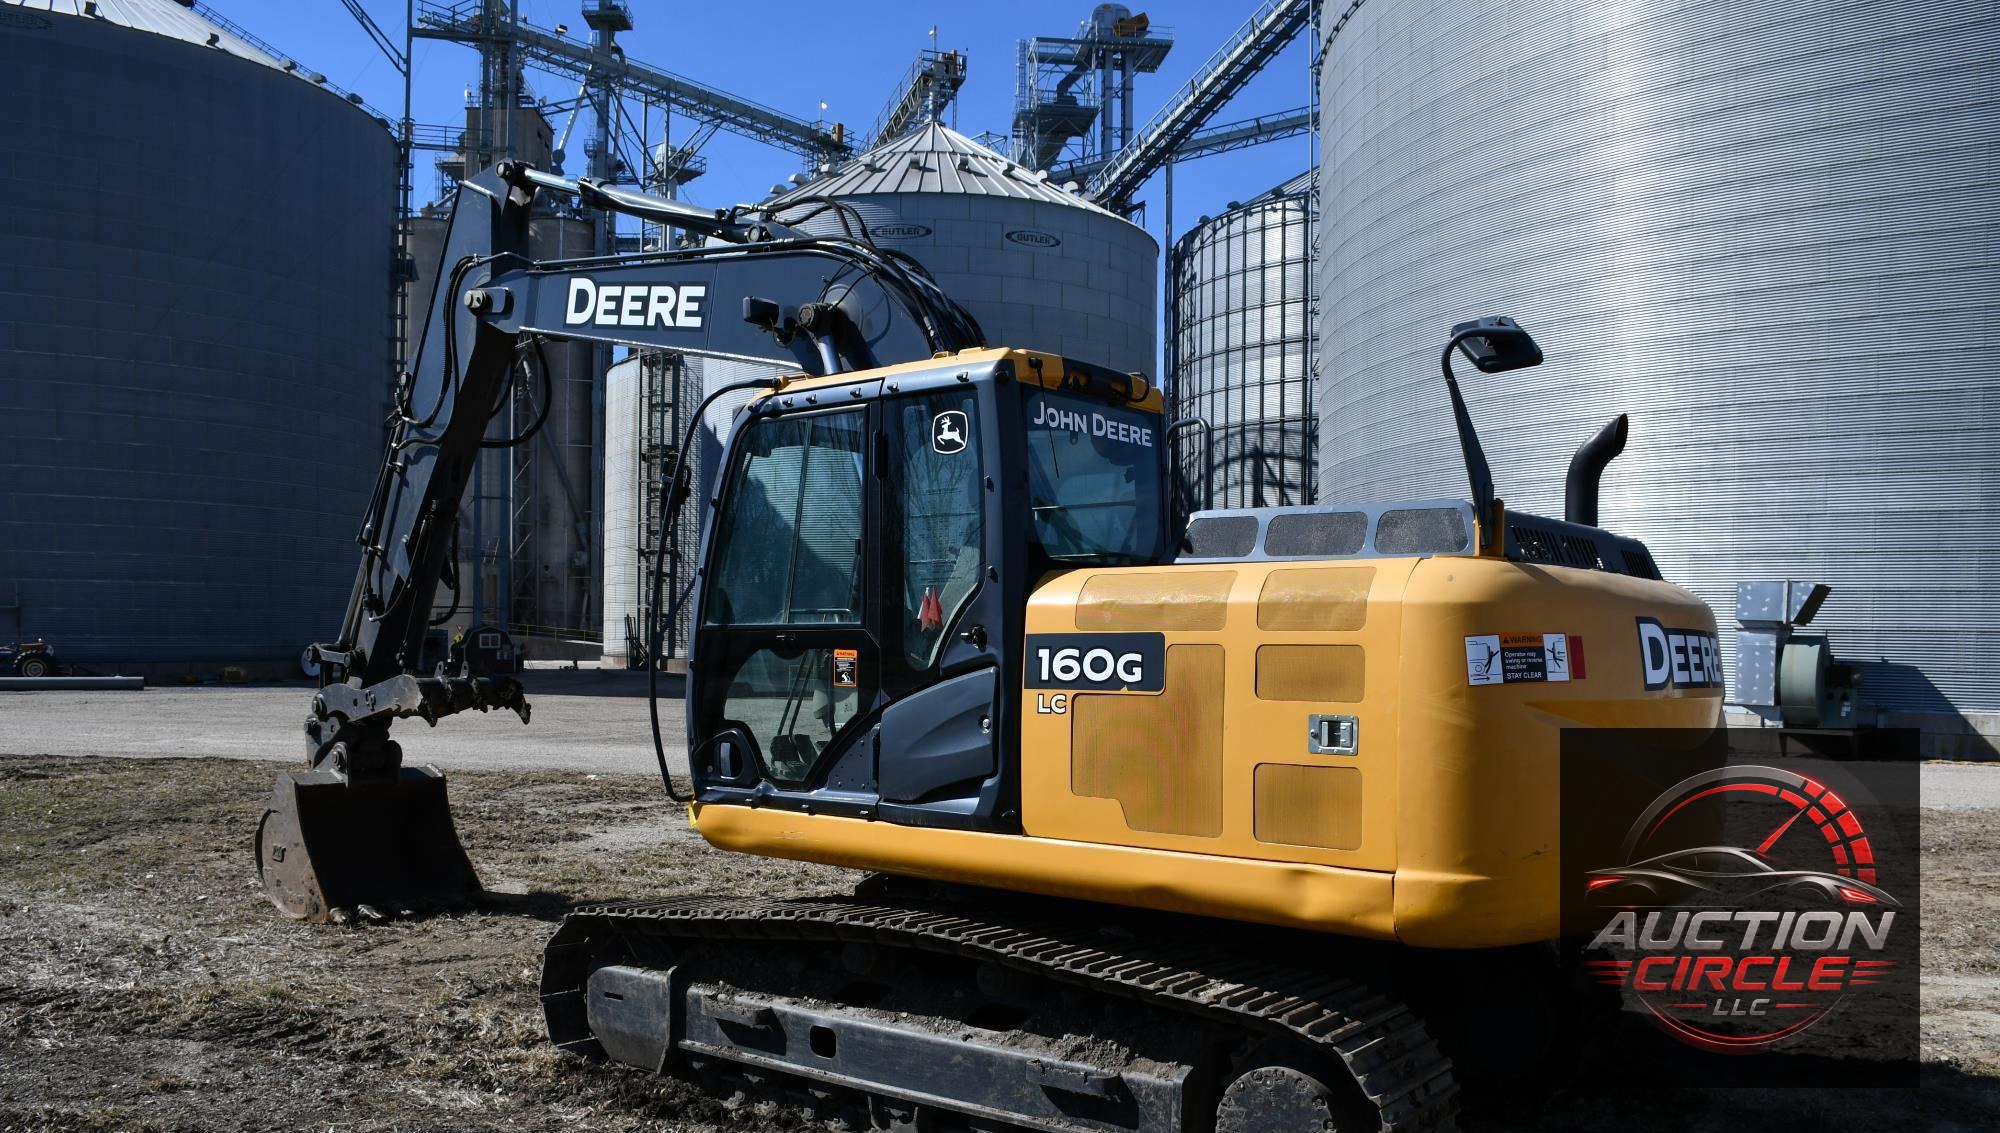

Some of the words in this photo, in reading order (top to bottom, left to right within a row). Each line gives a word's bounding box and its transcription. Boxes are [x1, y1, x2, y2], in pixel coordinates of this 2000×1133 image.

[881, 227, 920, 236] BUTLER
[1016, 233, 1051, 245] BUTLER
[565, 277, 706, 328] DEERE
[1033, 401, 1088, 434] JOHN
[1092, 412, 1153, 448] DEERE
[1509, 635, 1543, 644] WARNING
[1639, 622, 1721, 685] DEERE
[1038, 648, 1143, 683] 160G
[1523, 671, 1542, 679] CLEAR
[1037, 693, 1067, 715] LC
